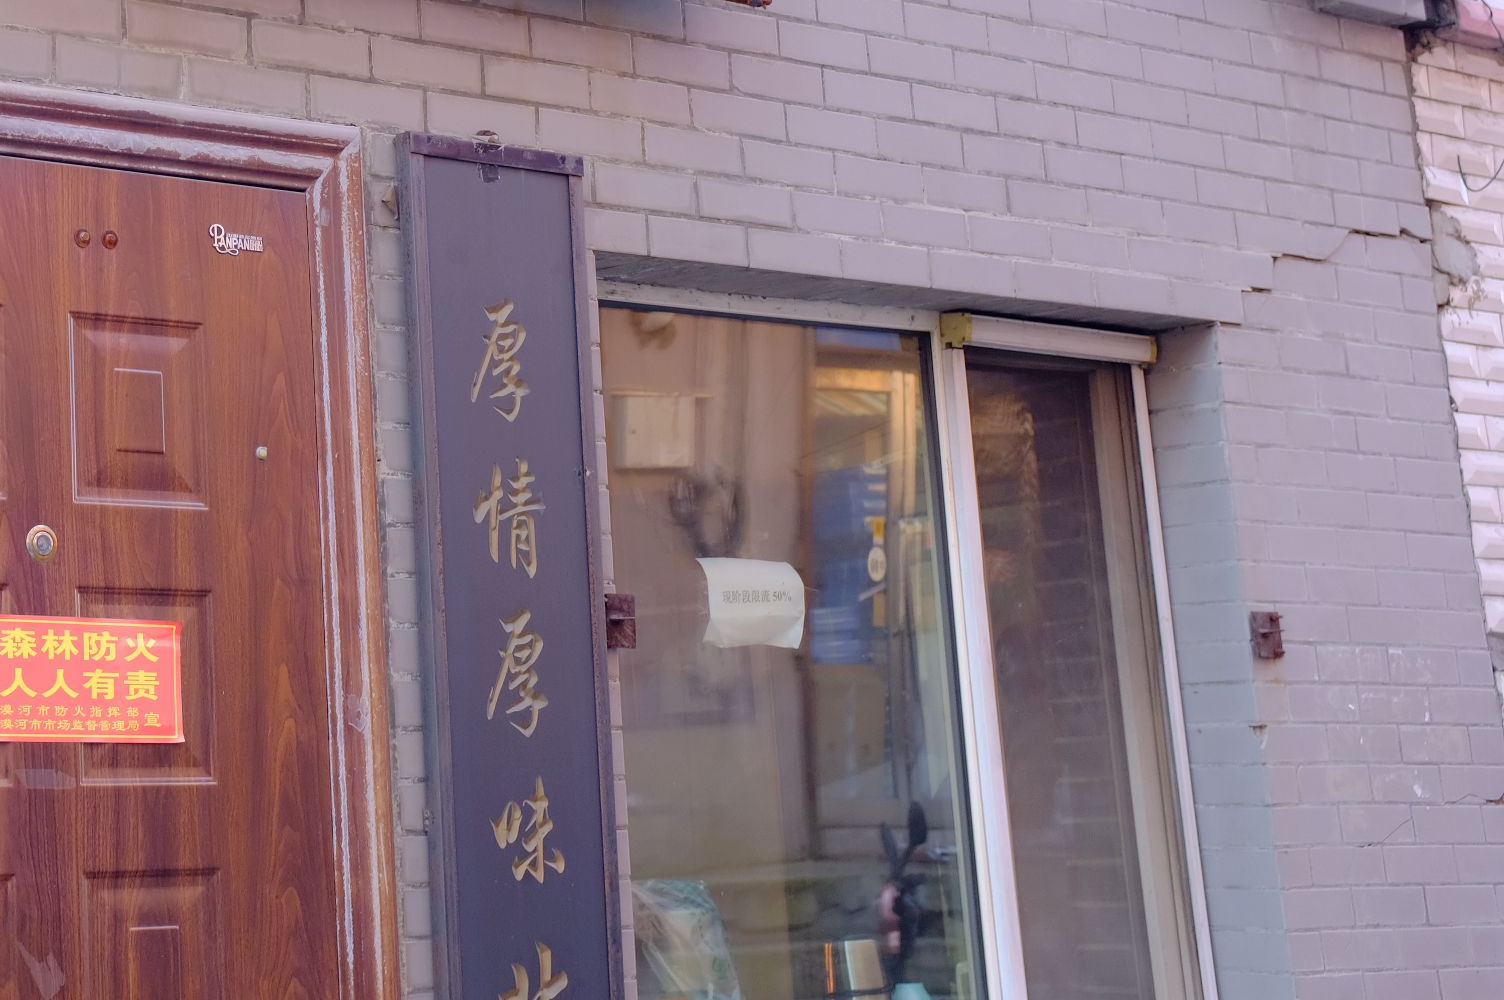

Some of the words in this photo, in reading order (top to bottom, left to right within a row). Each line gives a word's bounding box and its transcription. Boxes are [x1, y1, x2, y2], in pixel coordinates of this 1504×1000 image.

[0, 628, 160, 662] 森林防火
[0, 667, 160, 700] 人人有责
[0, 703, 140, 719] 漠河市防火指挥部
[144, 711, 162, 727] 宣
[0, 718, 140, 732] 漠河市市场监督管理局
